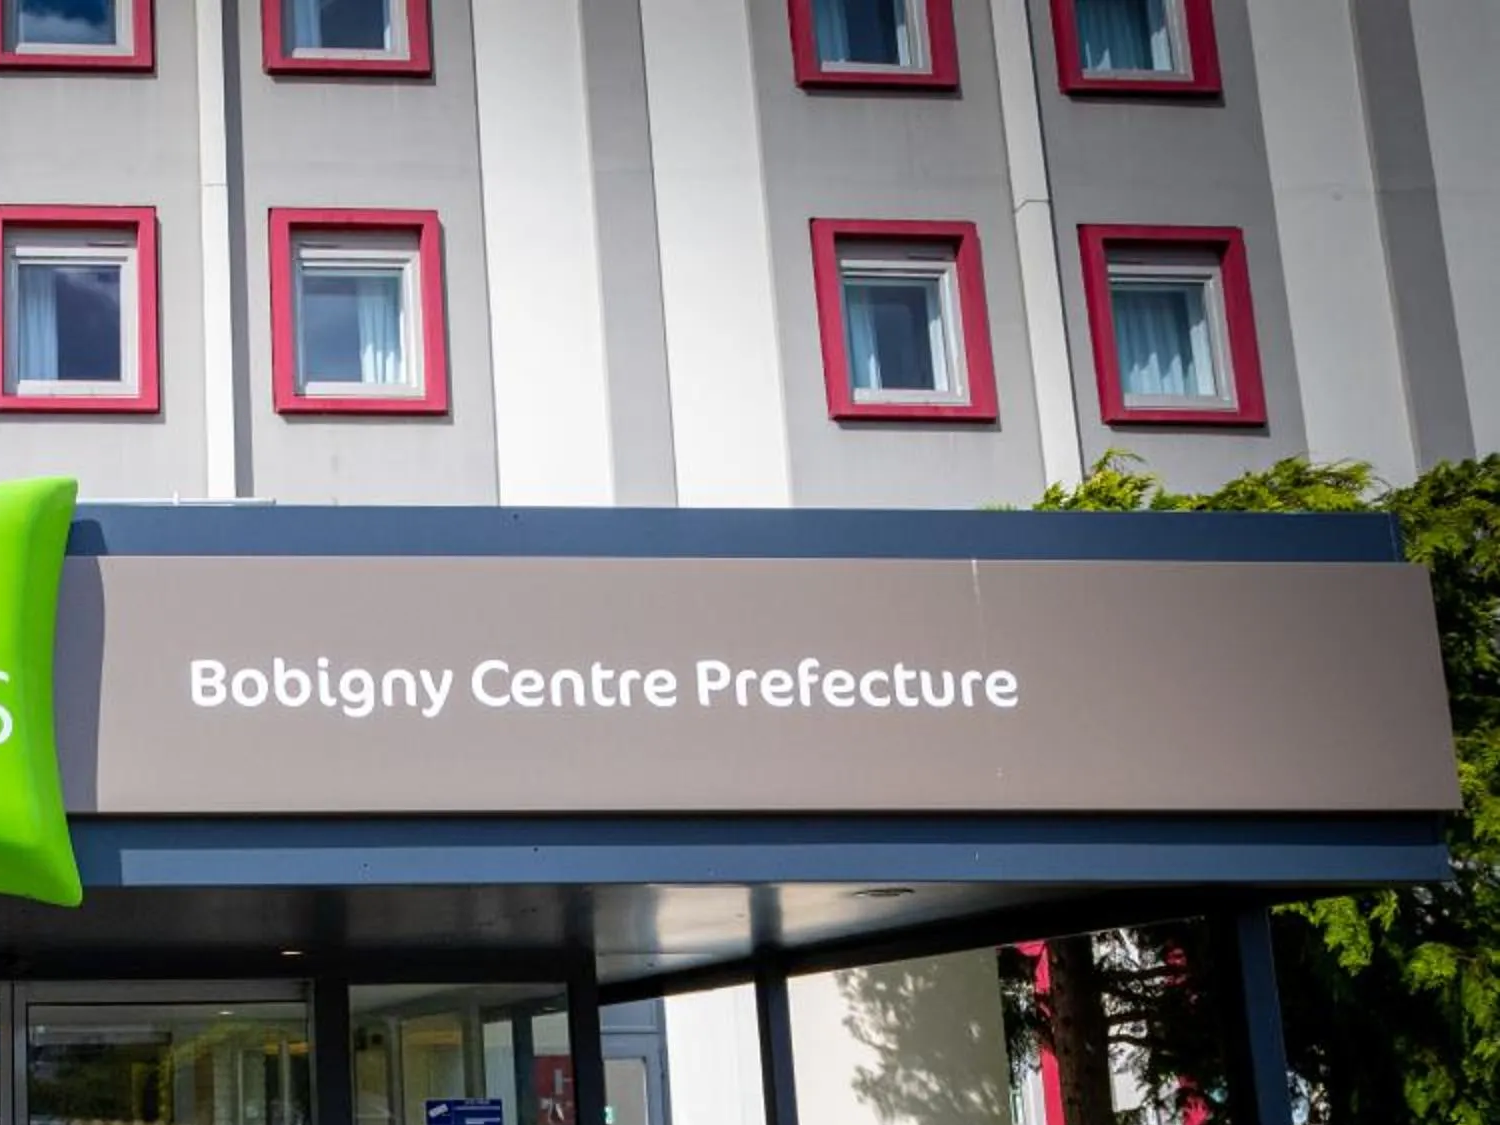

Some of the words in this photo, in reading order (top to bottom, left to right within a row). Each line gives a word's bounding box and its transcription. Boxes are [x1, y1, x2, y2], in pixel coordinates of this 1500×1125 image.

[189, 656, 454, 719] Bobigny
[470, 658, 678, 708] Centre
[695, 656, 1019, 709] Prefecture
